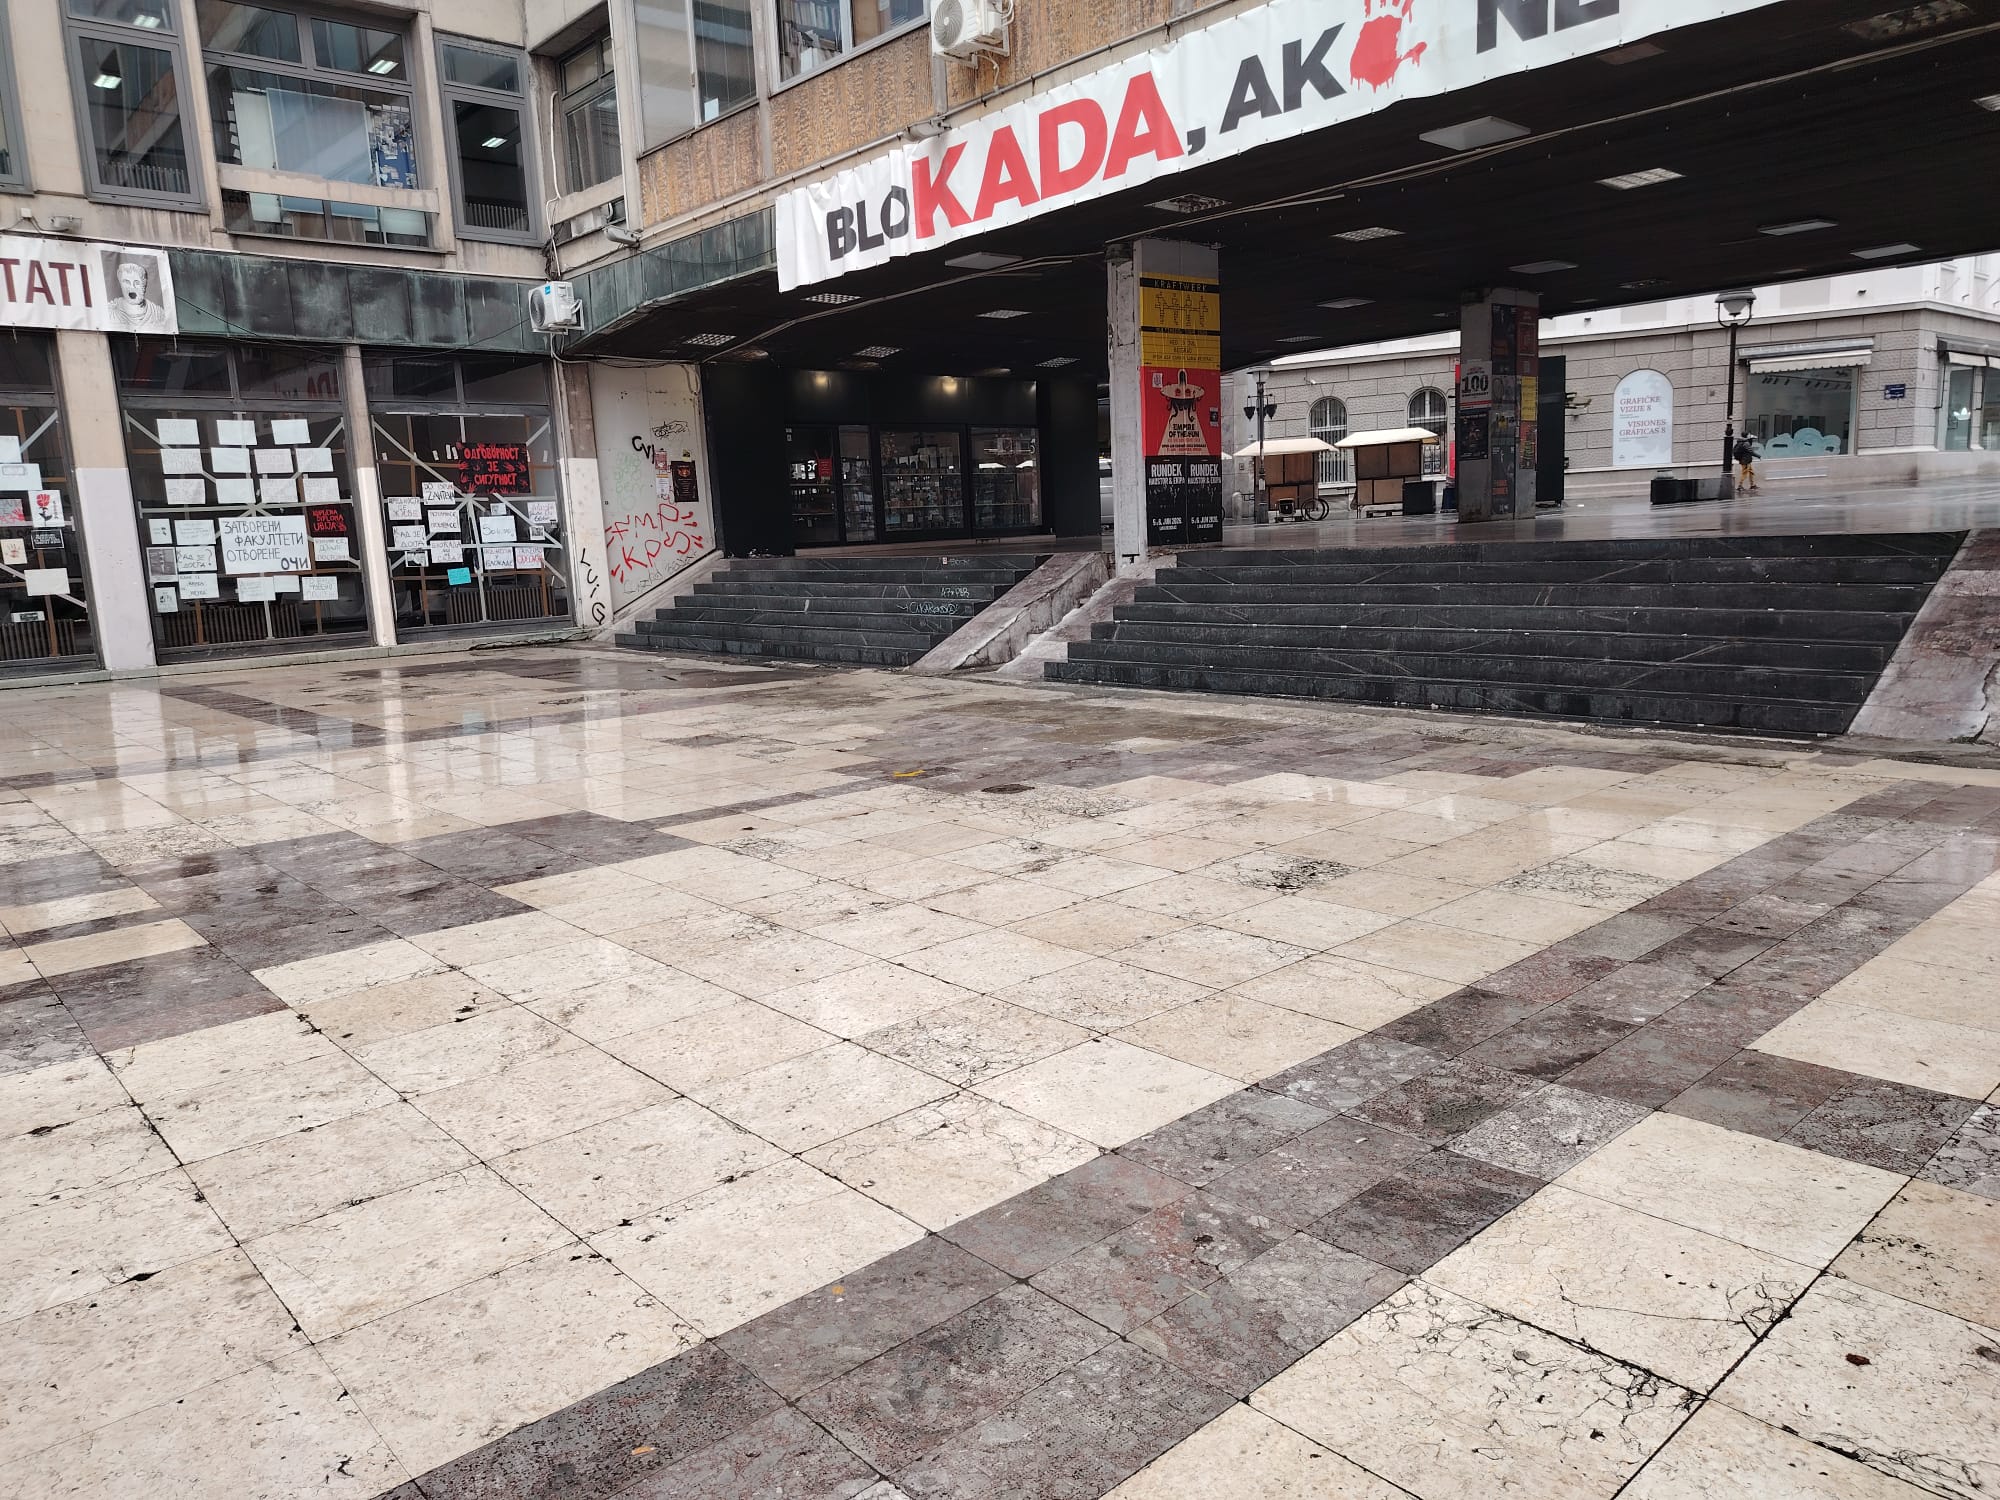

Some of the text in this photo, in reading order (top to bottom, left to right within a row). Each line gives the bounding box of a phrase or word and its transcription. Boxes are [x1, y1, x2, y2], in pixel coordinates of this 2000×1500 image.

[0, 257, 92, 308] TATI
[1154, 280, 1208, 292] KRAFTWERK
[1462, 374, 1488, 394] 100
[1619, 395, 1661, 405] GRAFIČKE
[1620, 405, 1645, 413] VIZIJE
[1627, 419, 1667, 428] VISIONES
[464, 447, 519, 460] ОДГОВОРНОСТ
[1151, 463, 1183, 478] RUNDEK
[1190, 463, 1219, 477] RUNDEK
[474, 473, 517, 486] СИГУРНОСТ
[224, 521, 282, 534] ЗАТВОРЕНИ
[313, 521, 337, 531] UBIJA
[234, 532, 304, 547] ФАКУЛТЕТИ
[226, 547, 281, 562] ОТВОРЕНЕ
[280, 557, 309, 570] ОЧИ
